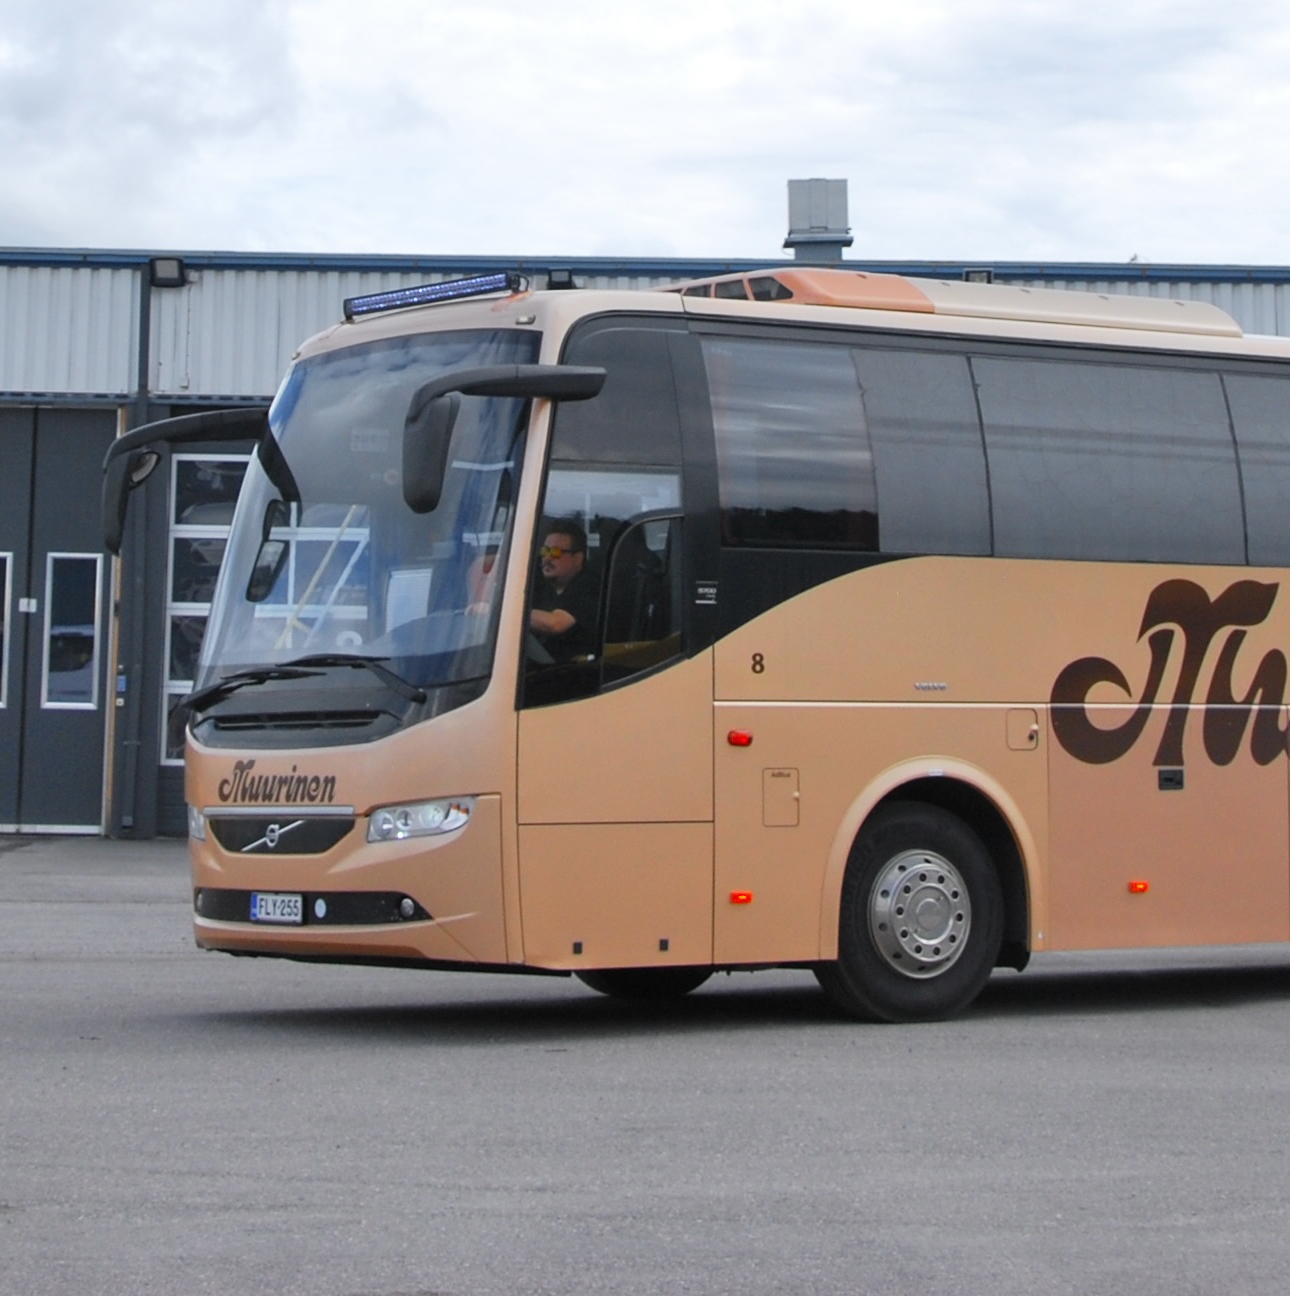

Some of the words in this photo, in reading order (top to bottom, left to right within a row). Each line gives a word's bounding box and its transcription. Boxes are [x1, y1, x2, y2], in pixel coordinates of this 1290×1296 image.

[751, 652, 765, 674] 8
[218, 760, 336, 802] Muurinen
[259, 898, 299, 917] FLY-255
